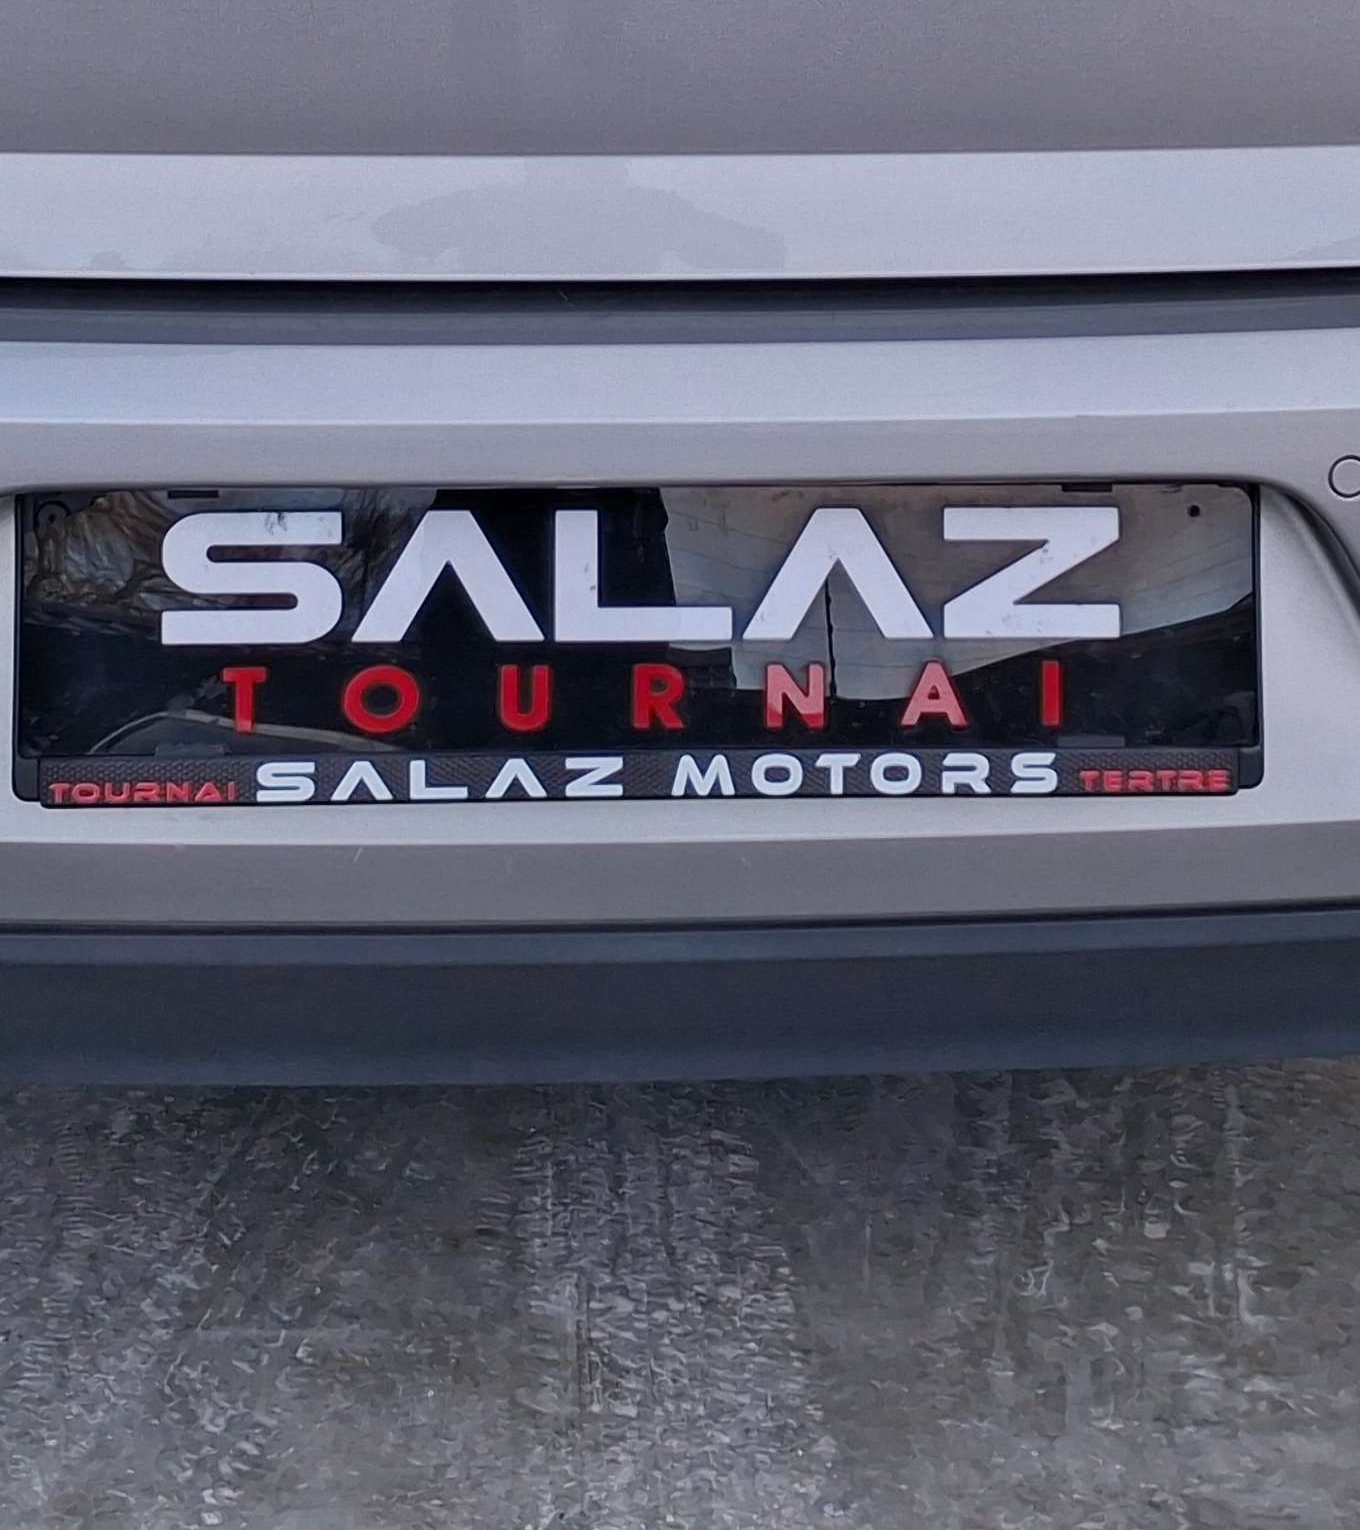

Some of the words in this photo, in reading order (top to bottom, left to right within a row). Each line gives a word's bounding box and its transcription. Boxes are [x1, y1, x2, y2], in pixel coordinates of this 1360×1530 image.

[160, 507, 1121, 645] SALAZ
[222, 660, 1064, 733] TOURNAI
[49, 781, 238, 805] TOURNAI
[256, 756, 625, 804] SALAZ
[670, 753, 1059, 797] MOTORS
[1078, 769, 1231, 793] TERTRE
